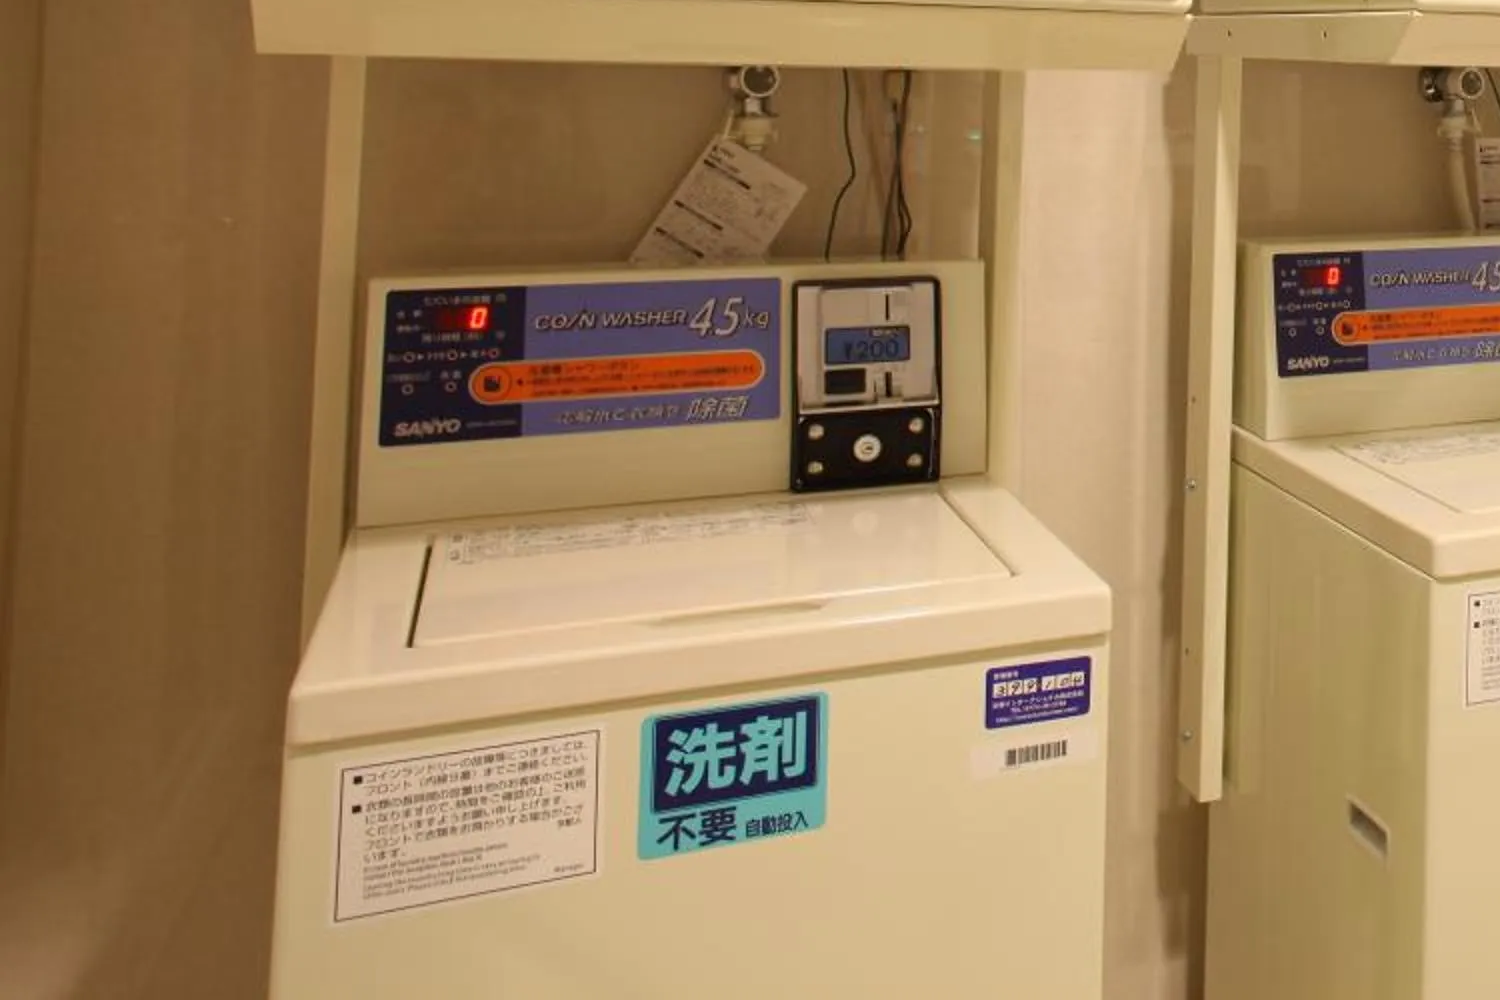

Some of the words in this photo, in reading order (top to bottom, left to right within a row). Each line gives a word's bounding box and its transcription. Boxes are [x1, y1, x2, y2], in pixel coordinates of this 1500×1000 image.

[469, 306, 488, 329] 0
[601, 308, 689, 328] WASHER
[1287, 355, 1330, 371] SANYO
[394, 418, 461, 437] SANYO
[664, 711, 808, 797] 洗剤
[656, 806, 737, 850] 不要
[745, 811, 809, 839] 自動投入
